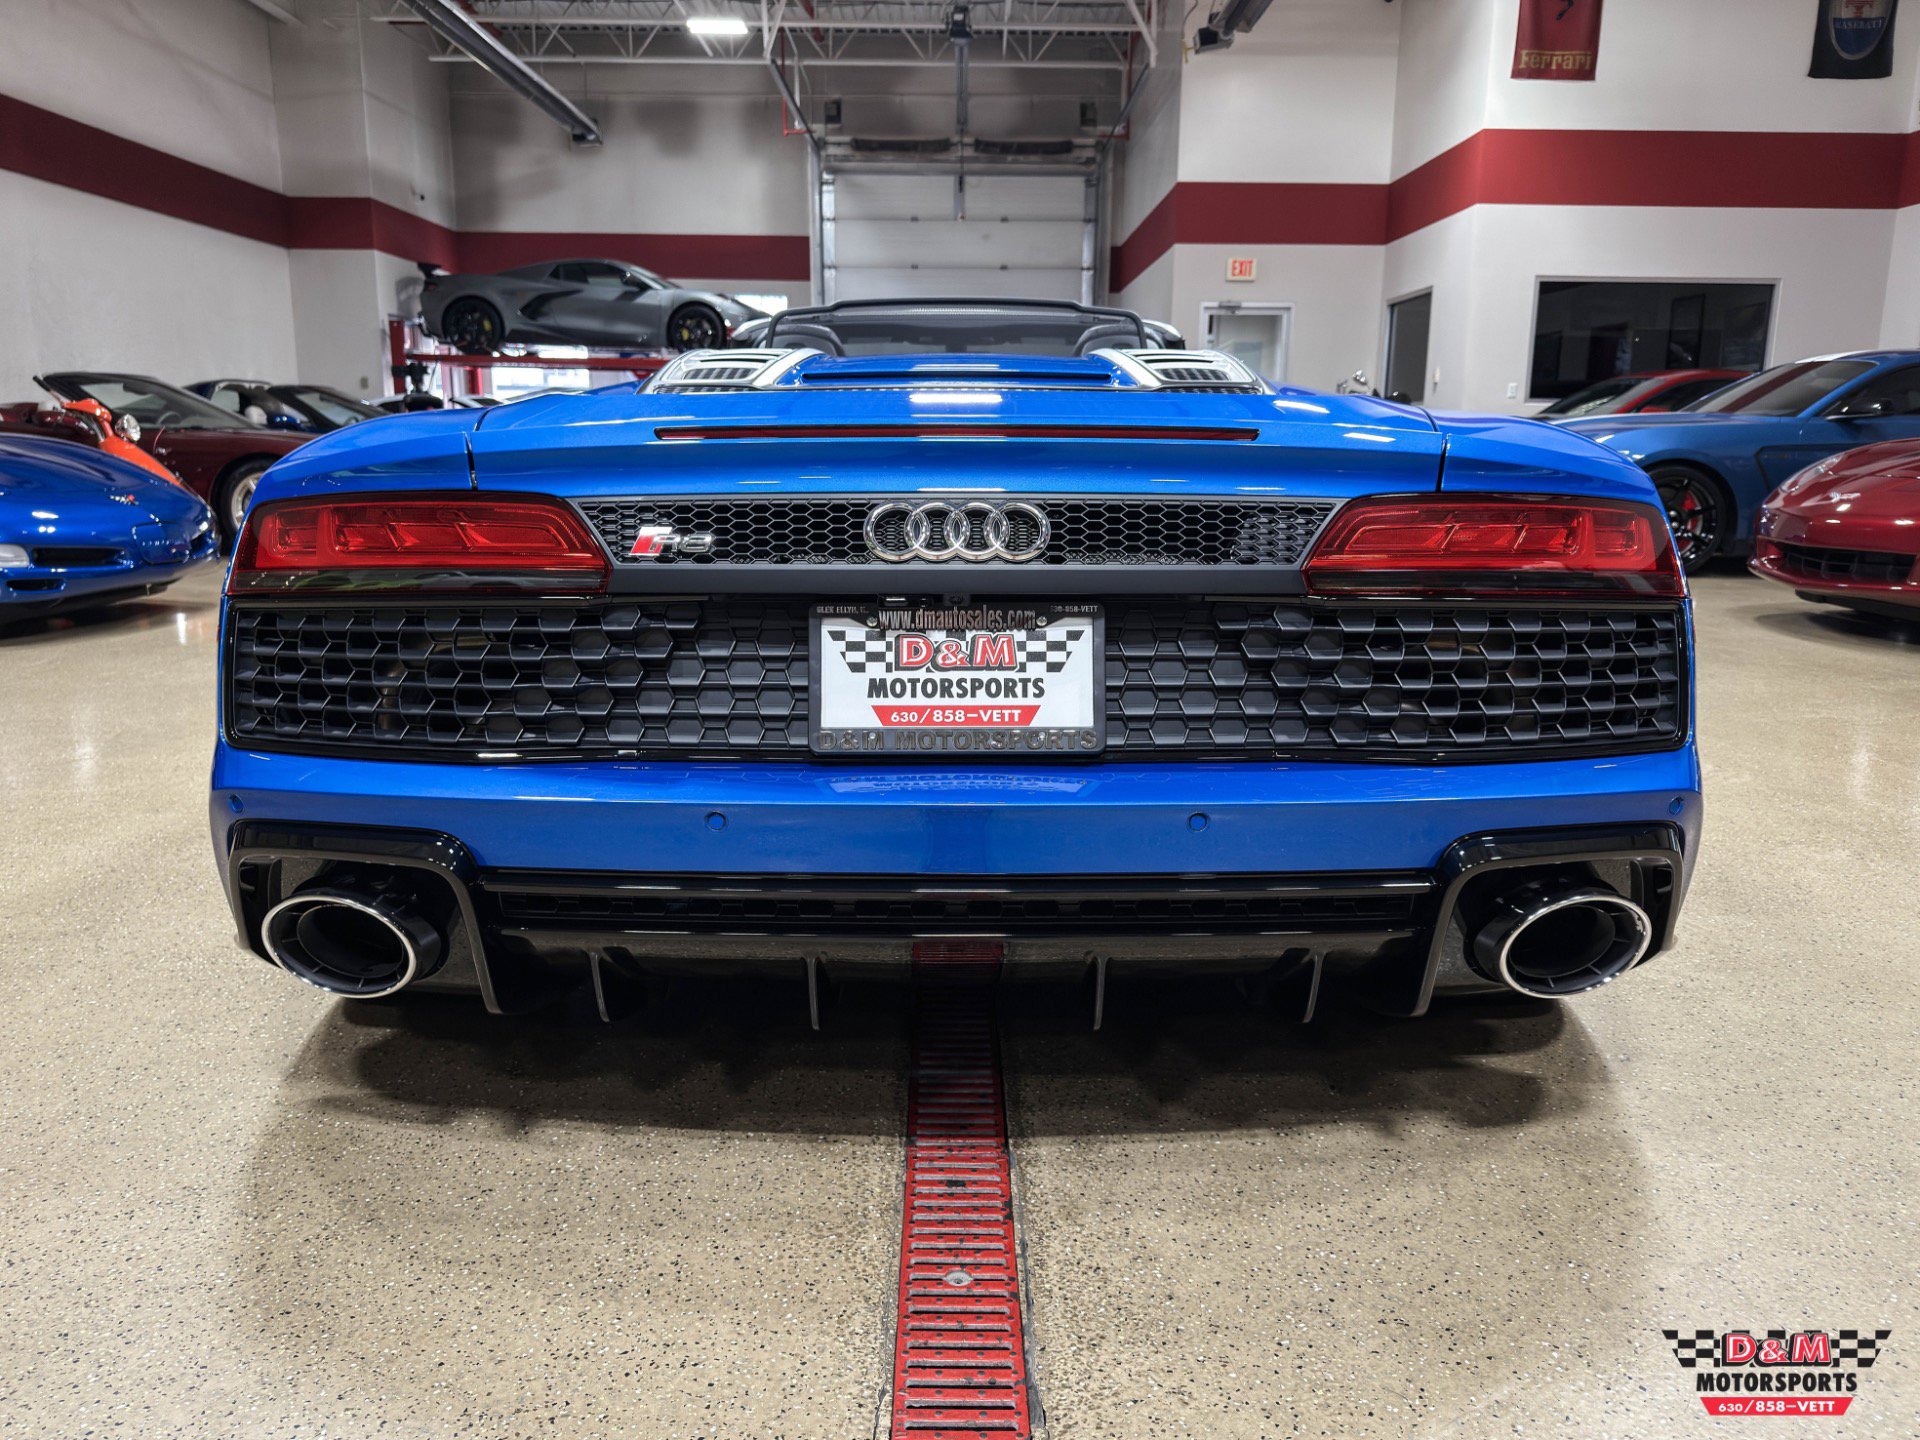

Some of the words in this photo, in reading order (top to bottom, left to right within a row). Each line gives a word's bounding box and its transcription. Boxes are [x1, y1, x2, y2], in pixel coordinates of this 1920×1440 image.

[1519, 49, 1593, 70] Ferrari
[1231, 258, 1254, 277] EXIT
[879, 605, 1036, 631] www.dmautosales.com
[896, 634, 1017, 670] D&M
[867, 677, 1045, 699] MOTORSPORTS
[818, 731, 885, 750] D&M
[895, 730, 1098, 750] MOTORSPORTS
